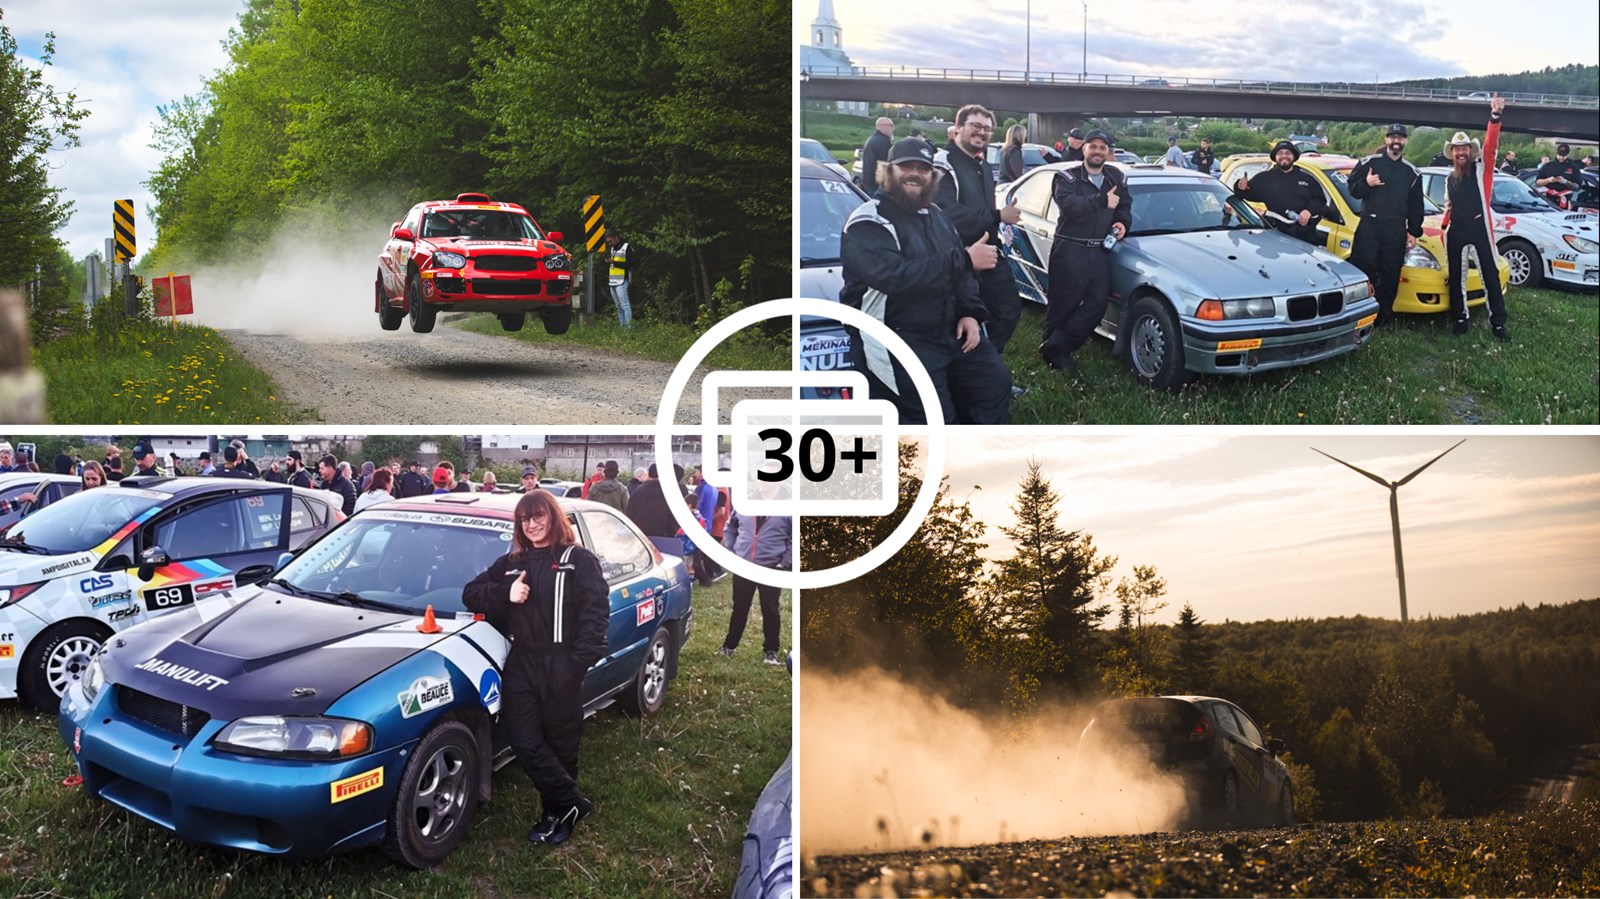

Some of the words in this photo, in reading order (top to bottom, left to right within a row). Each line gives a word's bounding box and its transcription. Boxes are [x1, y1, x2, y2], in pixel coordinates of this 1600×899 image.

[826, 181, 847, 194] 21
[41, 556, 92, 575] AMPDIGITAL.CA
[80, 574, 114, 594] CAS
[155, 587, 183, 606] 69
[134, 657, 229, 691] MANULIFT
[421, 685, 449, 704] BEAUCE
[336, 771, 380, 798] PIRELLI
